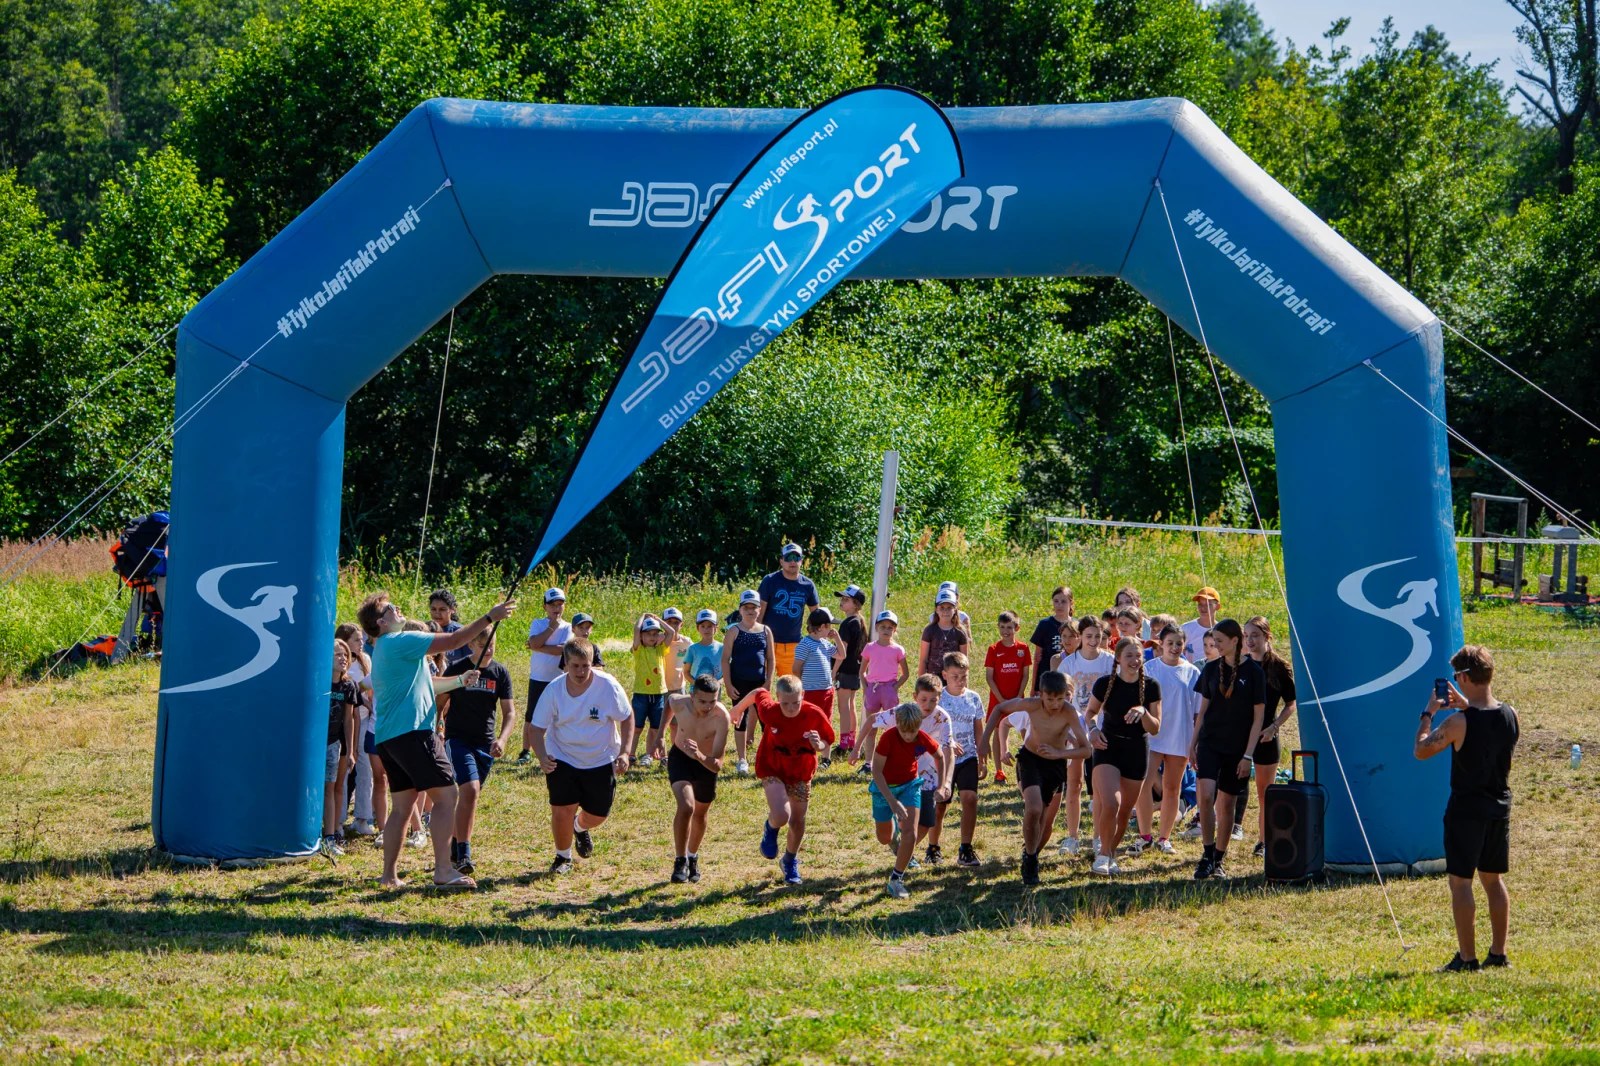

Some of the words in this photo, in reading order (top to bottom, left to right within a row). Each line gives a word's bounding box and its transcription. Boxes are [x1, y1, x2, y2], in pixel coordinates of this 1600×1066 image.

[742, 118, 839, 209] www.jafisport.pl
[276, 205, 421, 339] #TylkoJafiTakPotrafi
[658, 380, 711, 430] BIURO
[709, 299, 800, 381] TURYSTYKI
[796, 207, 897, 303] SPORTOWEJ
[1183, 208, 1337, 336] #TylkoJafiTakPotrafi
[773, 589, 805, 618] 25
